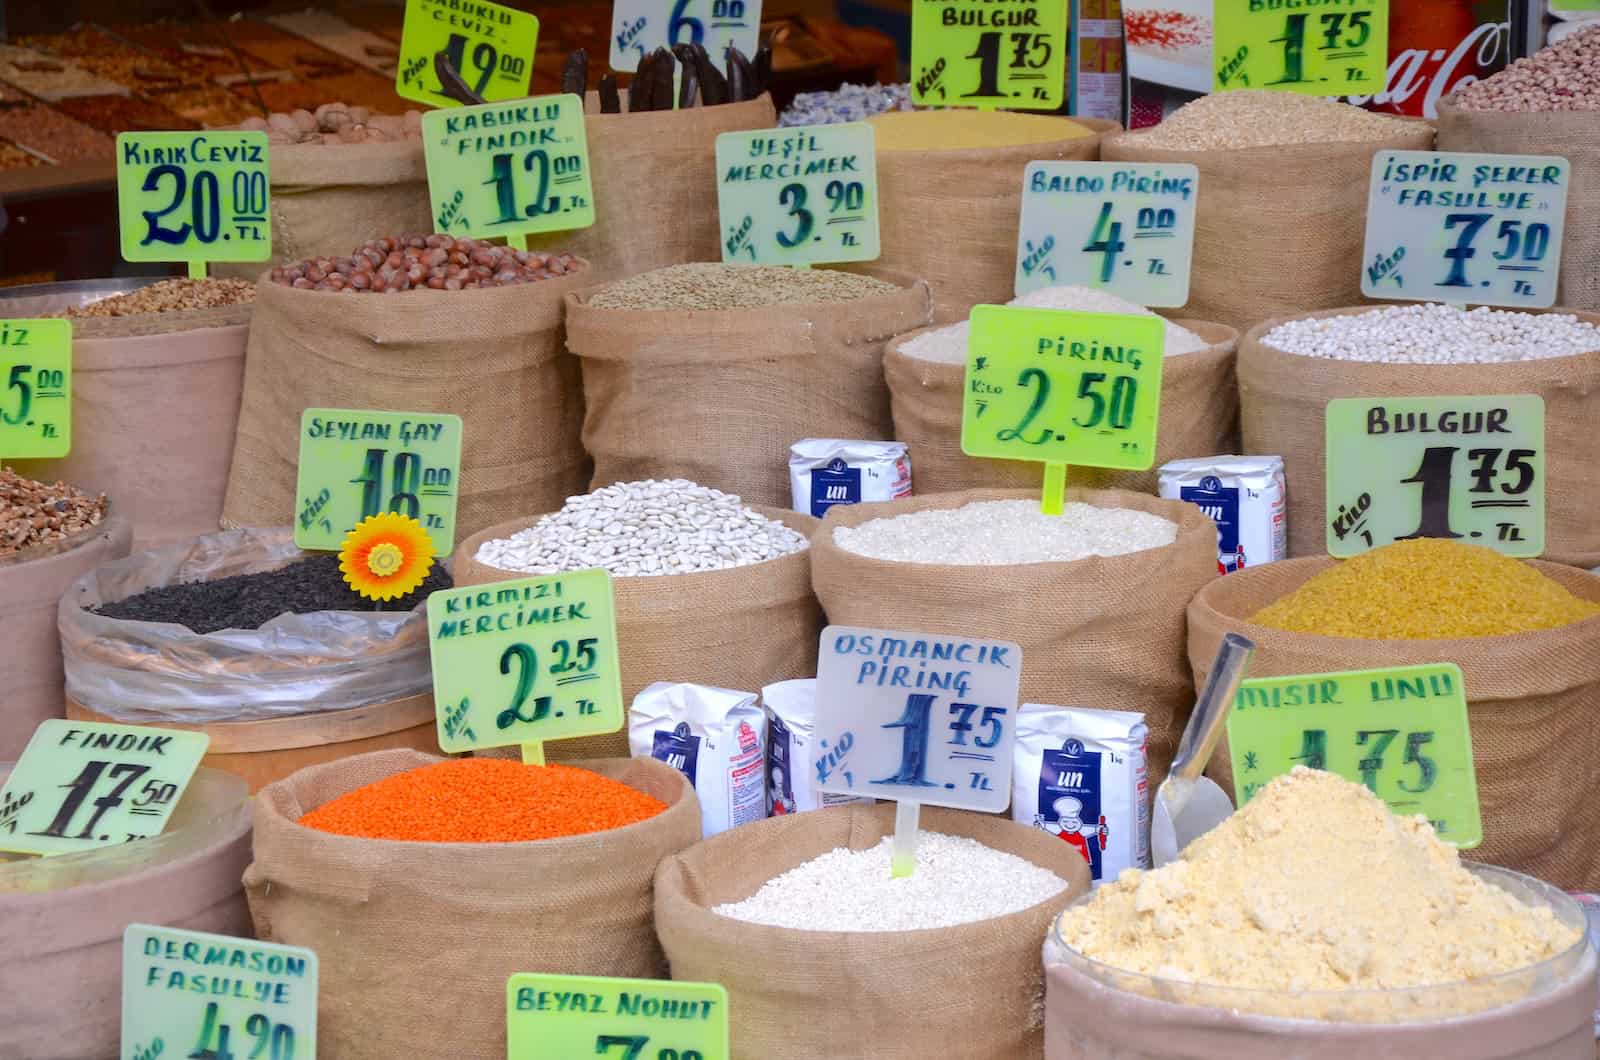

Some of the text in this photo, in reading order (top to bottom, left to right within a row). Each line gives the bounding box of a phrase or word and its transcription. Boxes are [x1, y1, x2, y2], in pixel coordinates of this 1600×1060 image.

[942, 8, 1040, 27] BULGUR
[1346, 68, 1370, 81] TL
[1033, 87, 1050, 100] TL
[446, 104, 560, 134] KABUKLU
[124, 142, 188, 165] KIRIK
[1031, 170, 1104, 193] BALDO
[1473, 164, 1561, 188] ŞEKER
[570, 196, 588, 208] TL
[841, 232, 861, 246] TL
[1147, 258, 1173, 275] TL
[1513, 280, 1537, 296] TL
[308, 417, 391, 440] SEYLAN
[1367, 406, 1512, 434] BULGUR
[42, 424, 59, 438] TL
[826, 485, 848, 499] un
[426, 514, 444, 528] TL
[1496, 522, 1525, 541] TL
[446, 582, 562, 613] KIRMIZI
[834, 635, 1010, 668] OSMANCIK
[1236, 673, 1454, 710] MISIR UNU
[576, 700, 600, 715] TL
[60, 730, 173, 755] FINDIK
[969, 772, 993, 791] TL
[1058, 771, 1083, 787] un
[144, 937, 305, 977] DERMASON
[147, 967, 290, 1003] FASULYE
[516, 987, 716, 1020] BEYAZ NOHUT
